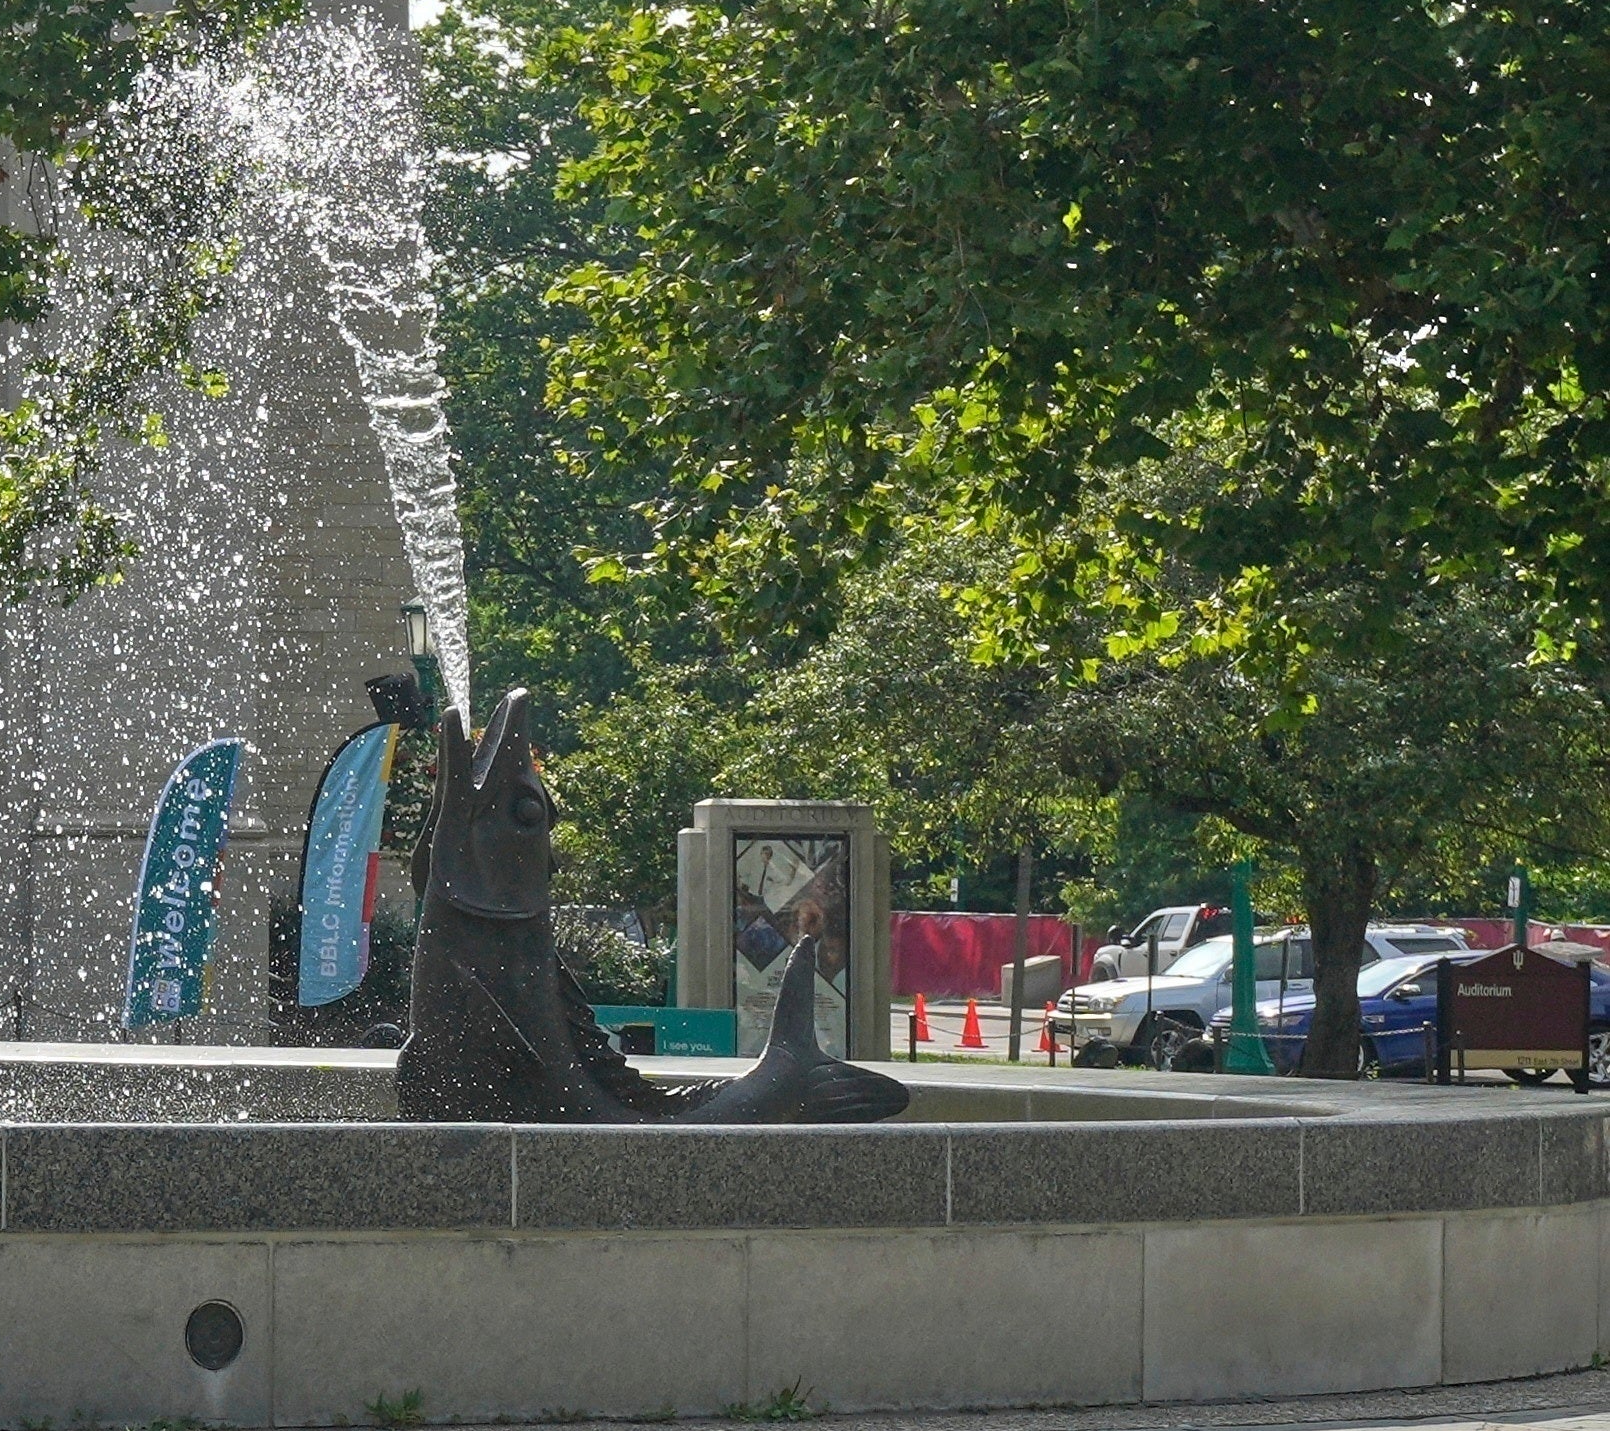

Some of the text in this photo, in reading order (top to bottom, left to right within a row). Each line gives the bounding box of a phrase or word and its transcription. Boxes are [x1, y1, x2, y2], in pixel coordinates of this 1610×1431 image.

[320, 776, 360, 978] BBLC Information
[1457, 983, 1512, 997] Auditorium
